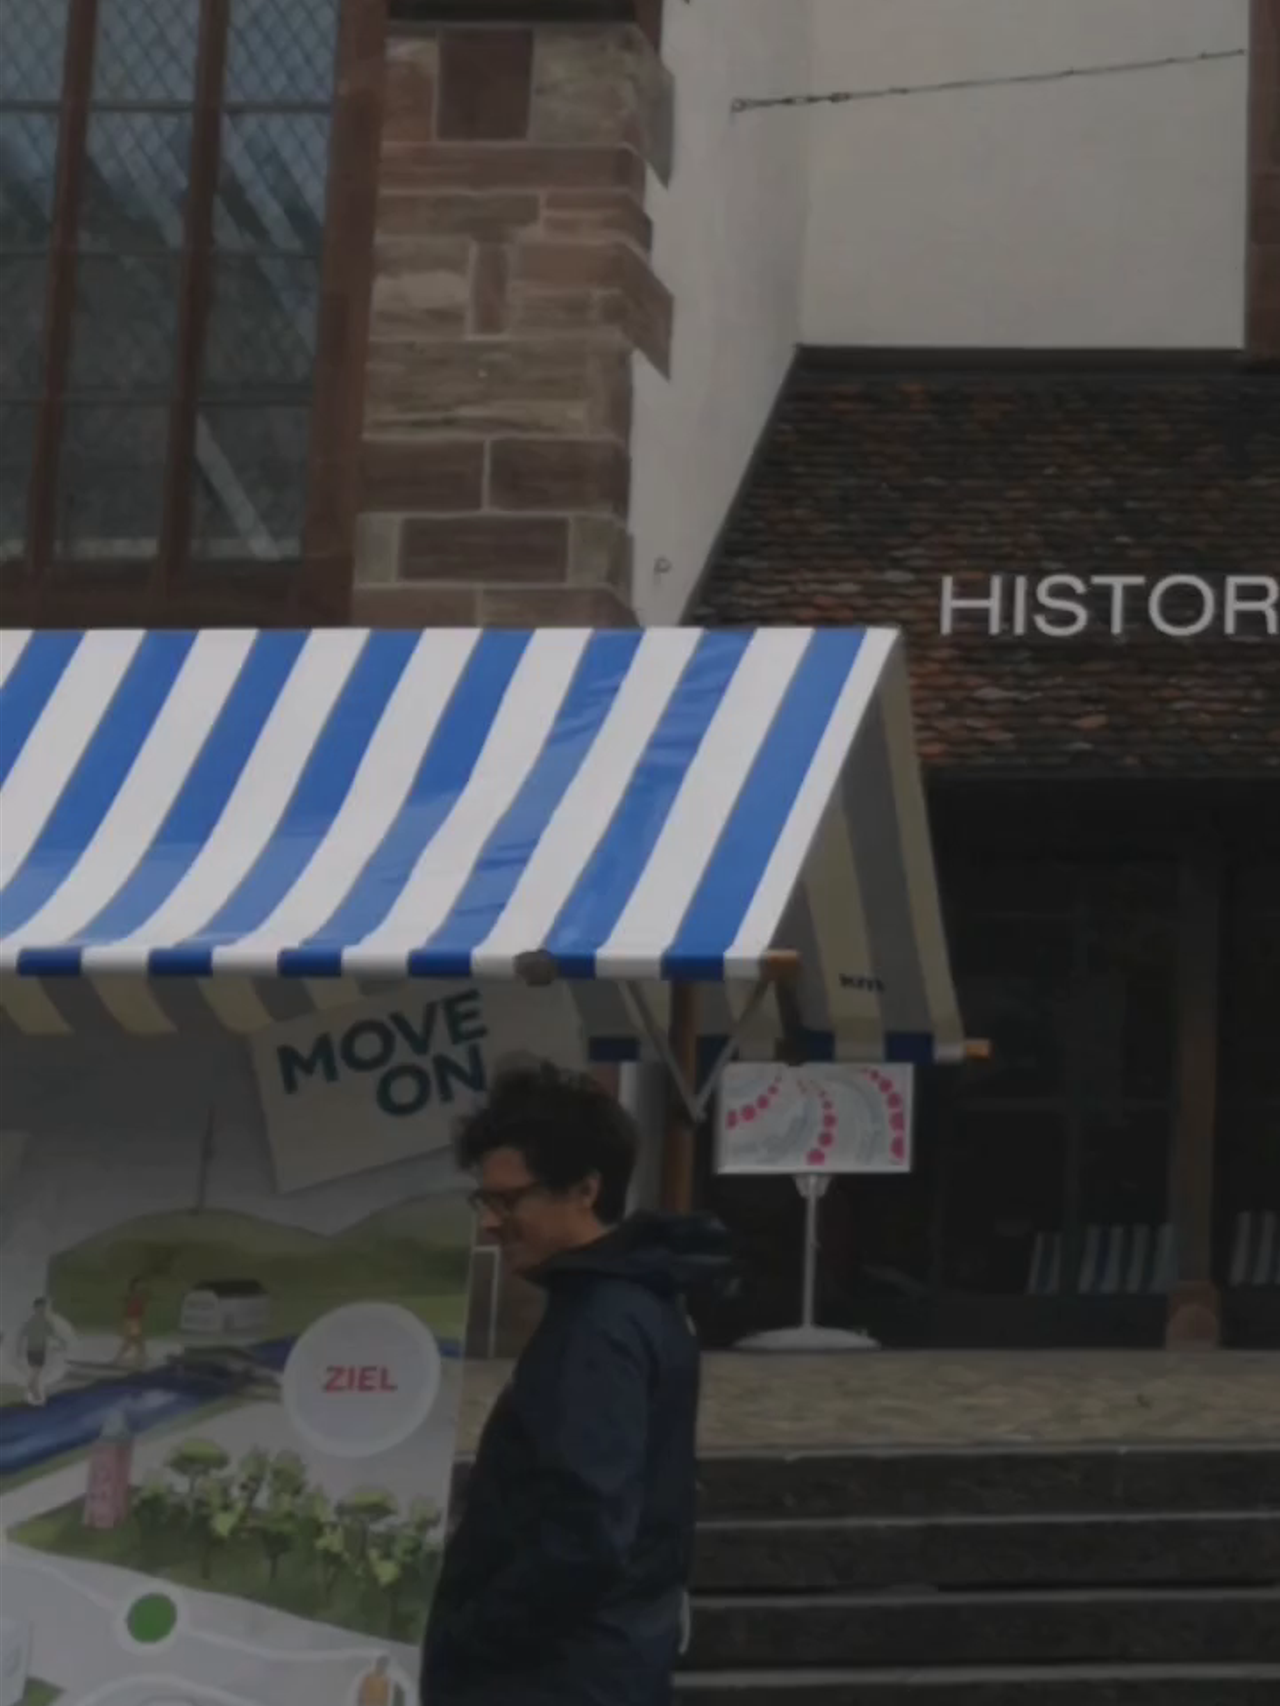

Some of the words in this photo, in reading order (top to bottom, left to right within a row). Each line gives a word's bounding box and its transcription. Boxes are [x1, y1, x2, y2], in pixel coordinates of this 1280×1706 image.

[277, 989, 488, 1094] MOVE
[376, 1043, 487, 1116] ON
[322, 1365, 398, 1393] ZIEL
